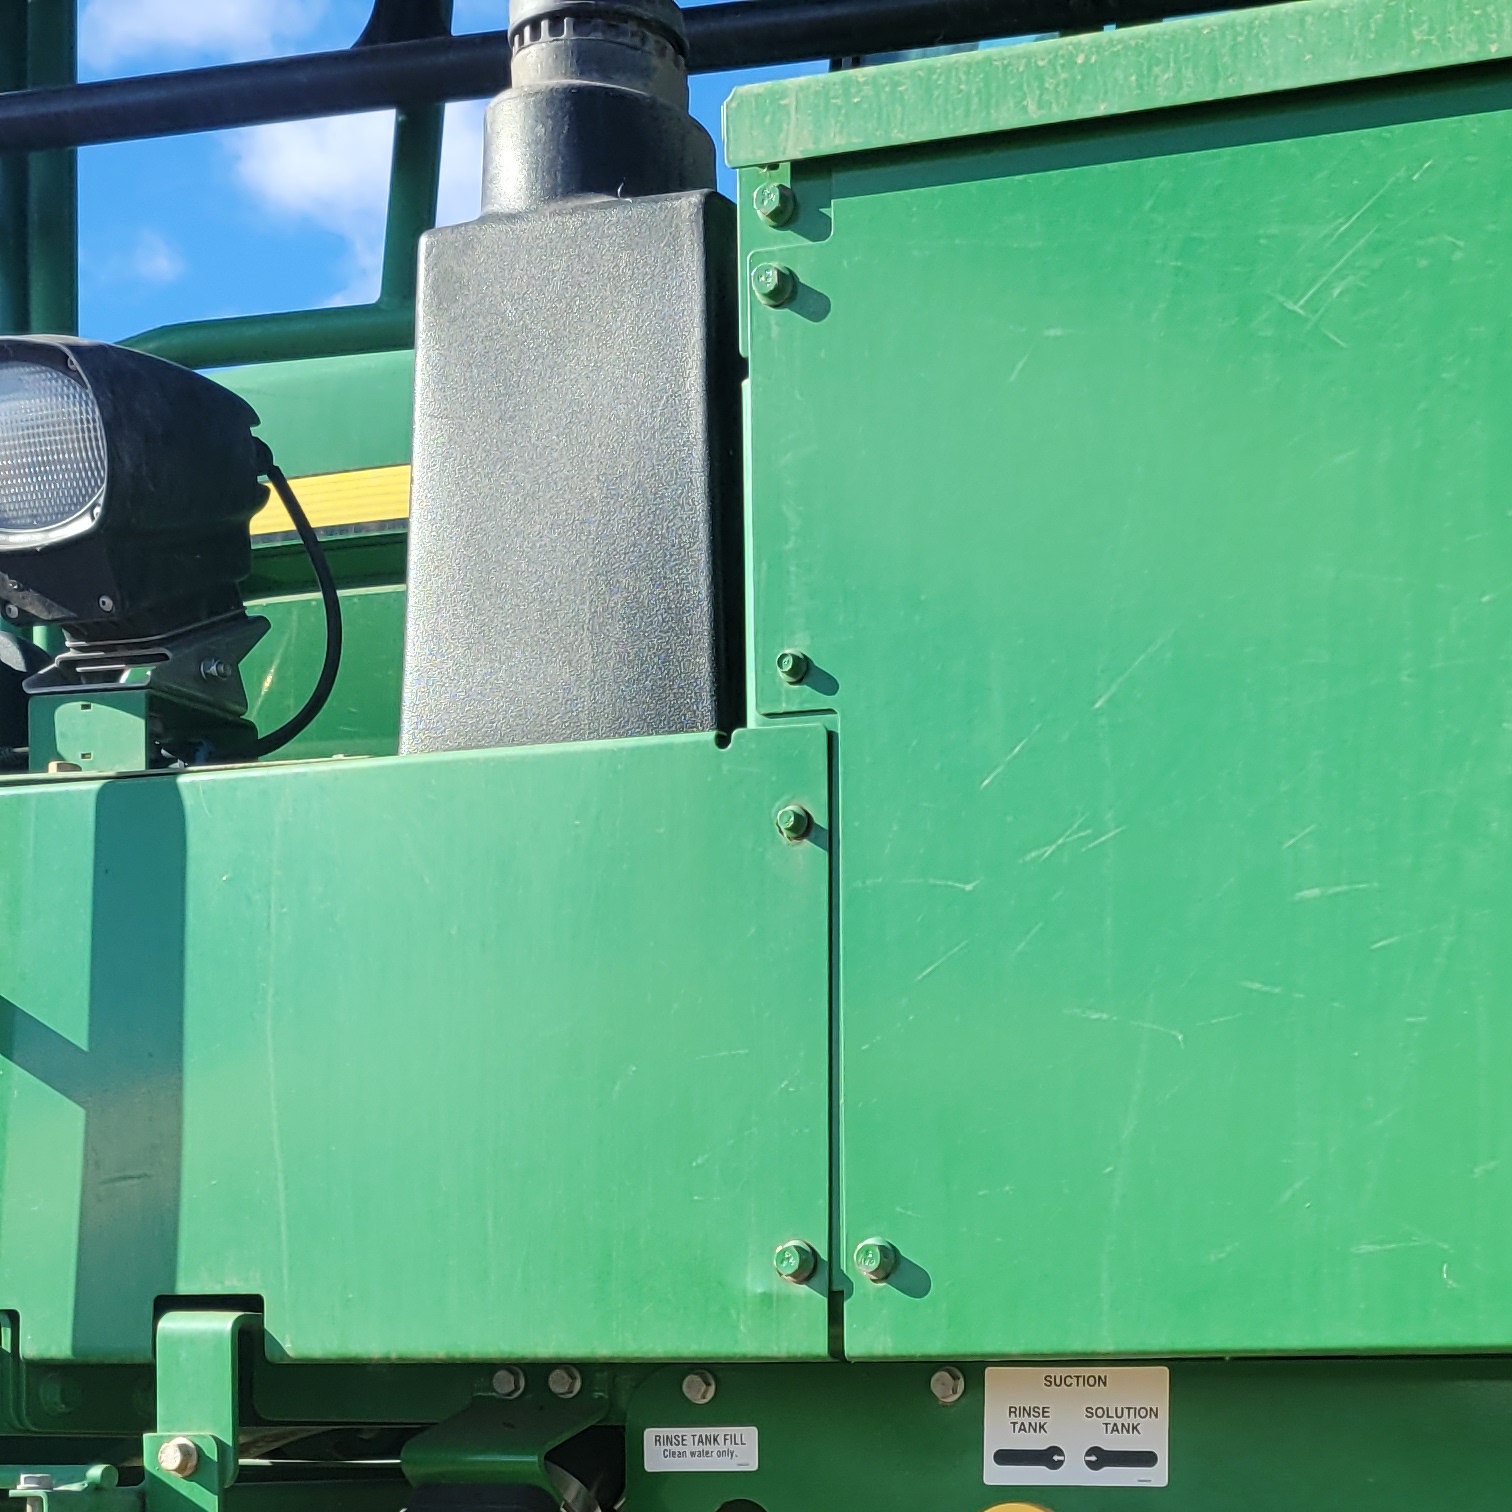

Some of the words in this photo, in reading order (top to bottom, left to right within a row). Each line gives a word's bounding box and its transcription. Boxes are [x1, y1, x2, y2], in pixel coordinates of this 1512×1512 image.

[1043, 1375, 1108, 1388] SUCTION
[1008, 1406, 1051, 1419] RINSE
[1085, 1406, 1159, 1419] SOLUTION
[1010, 1421, 1048, 1434] TANK
[1102, 1422, 1141, 1435] TANK
[654, 1434, 688, 1447] RINSE
[691, 1434, 721, 1446] TANK
[723, 1433, 746, 1446] FILL
[663, 1449, 687, 1459] Clean
[690, 1449, 715, 1458] water
[716, 1448, 739, 1460] only.
